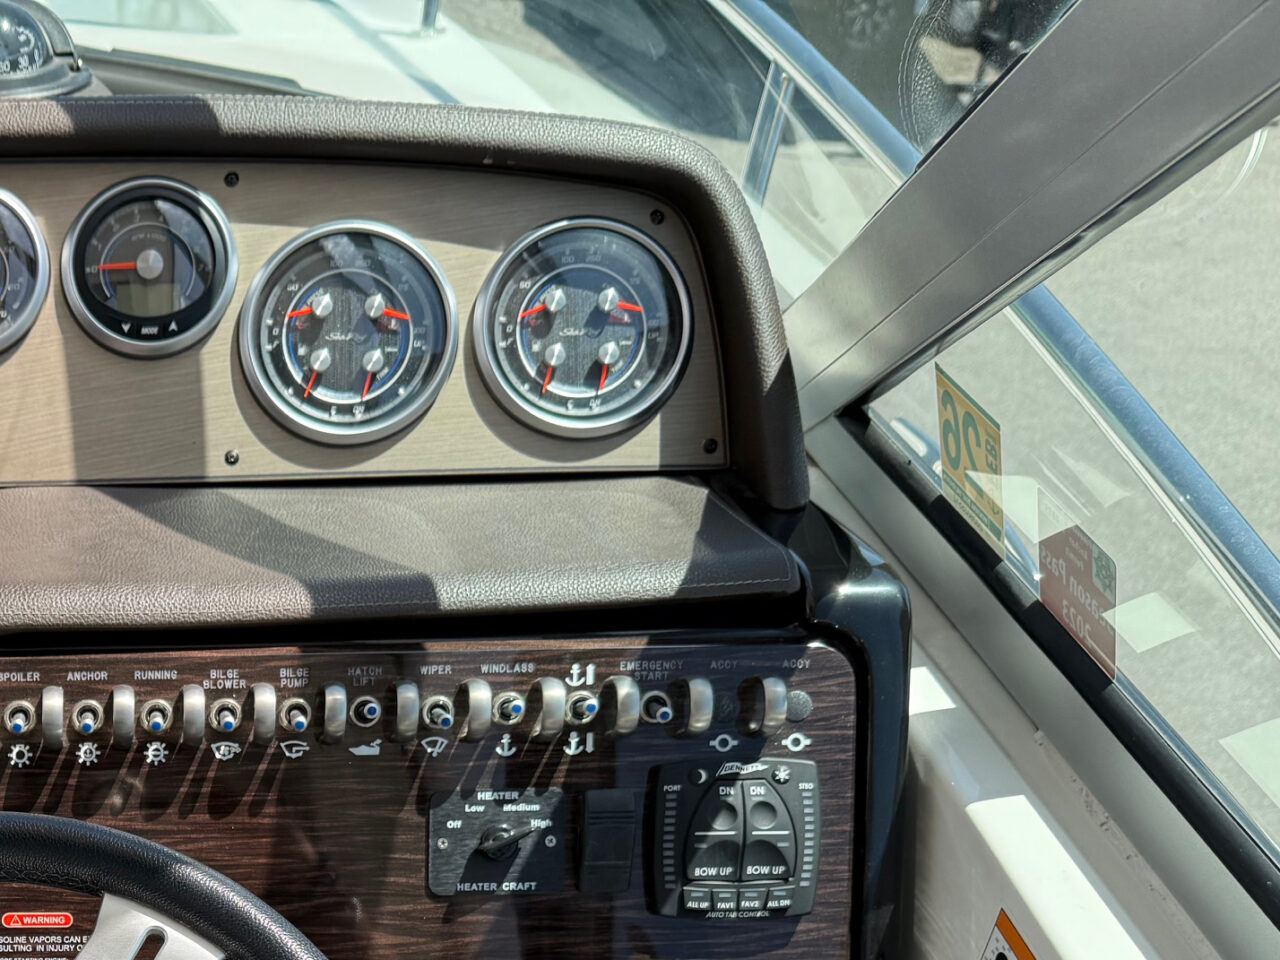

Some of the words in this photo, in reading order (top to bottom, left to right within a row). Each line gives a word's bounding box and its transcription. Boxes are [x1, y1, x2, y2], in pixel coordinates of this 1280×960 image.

[141, 326, 159, 334] MODE
[480, 663, 535, 673] WINDLASS
[620, 660, 684, 671] EMERGENCY
[710, 660, 738, 670] ACCY
[783, 659, 811, 669] ACCY
[134, 670, 178, 680] RUNNING
[210, 669, 239, 679] BILGE
[280, 668, 309, 678] BILGE
[348, 666, 383, 676] HATCH
[420, 665, 452, 675] WIPER
[67, 671, 108, 681] ANCHOR
[634, 671, 670, 681] START
[203, 679, 247, 690] BLOWER
[280, 679, 309, 689] PUMP
[353, 677, 376, 687] LIFT
[477, 791, 519, 800] HEATER
[719, 787, 734, 795] DN
[750, 786, 765, 795] DN
[465, 804, 485, 812] Low
[503, 803, 540, 811] Medium
[447, 820, 462, 828] Off
[531, 819, 552, 829] High
[694, 867, 716, 876] BOW
[720, 867, 733, 876] UP
[747, 866, 769, 875] BOW
[772, 866, 785, 874] UP
[457, 883, 497, 891] HEATER
[502, 882, 537, 891] CRAFT
[23, 916, 65, 924] WARNING
[63, 935, 80, 943] CAN
[46, 944, 74, 952] INJURY
